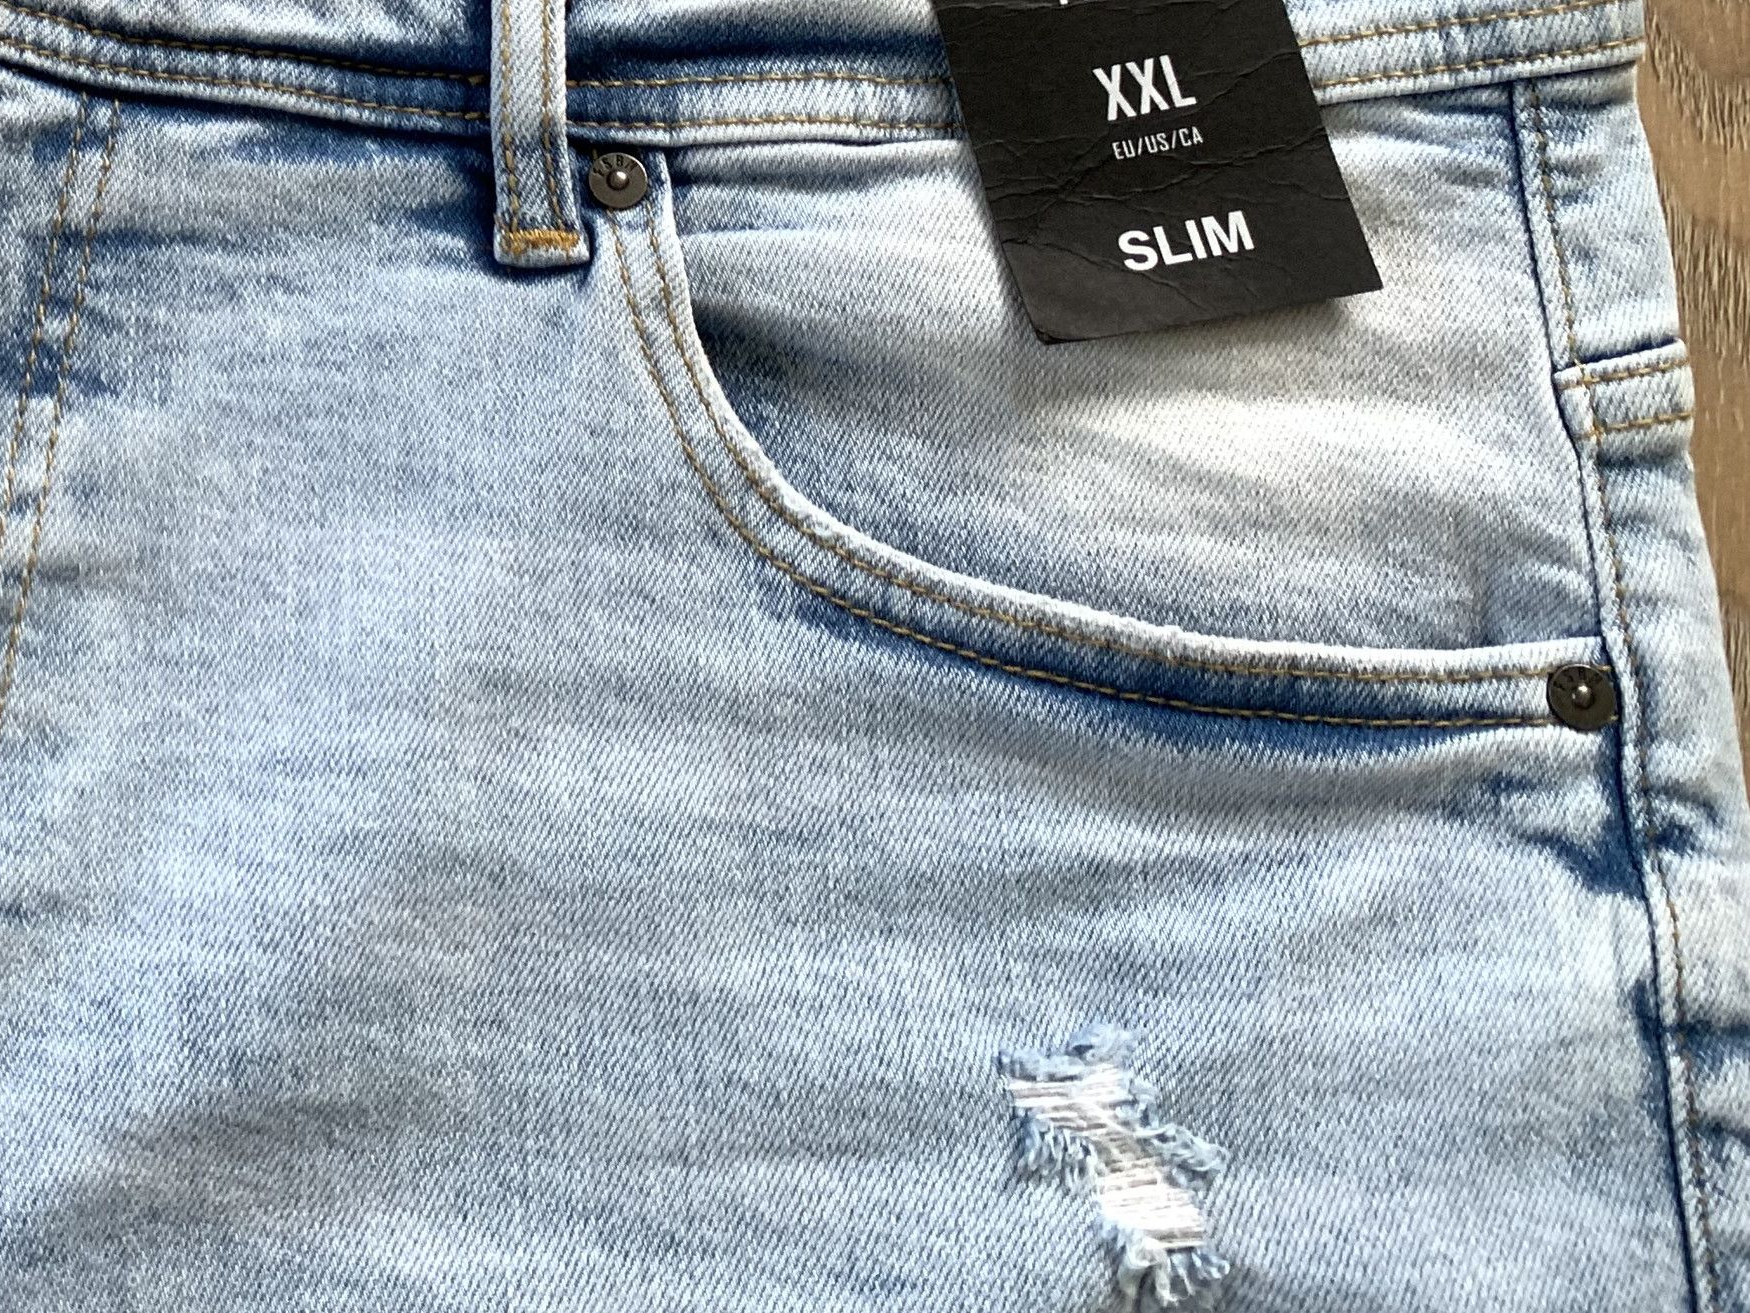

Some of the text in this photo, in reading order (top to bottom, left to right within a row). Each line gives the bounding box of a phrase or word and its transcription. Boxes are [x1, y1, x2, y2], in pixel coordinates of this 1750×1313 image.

[1092, 54, 1197, 121] XXL
[1112, 126, 1204, 160] EU/US/CA
[1117, 210, 1255, 272] SLIM
